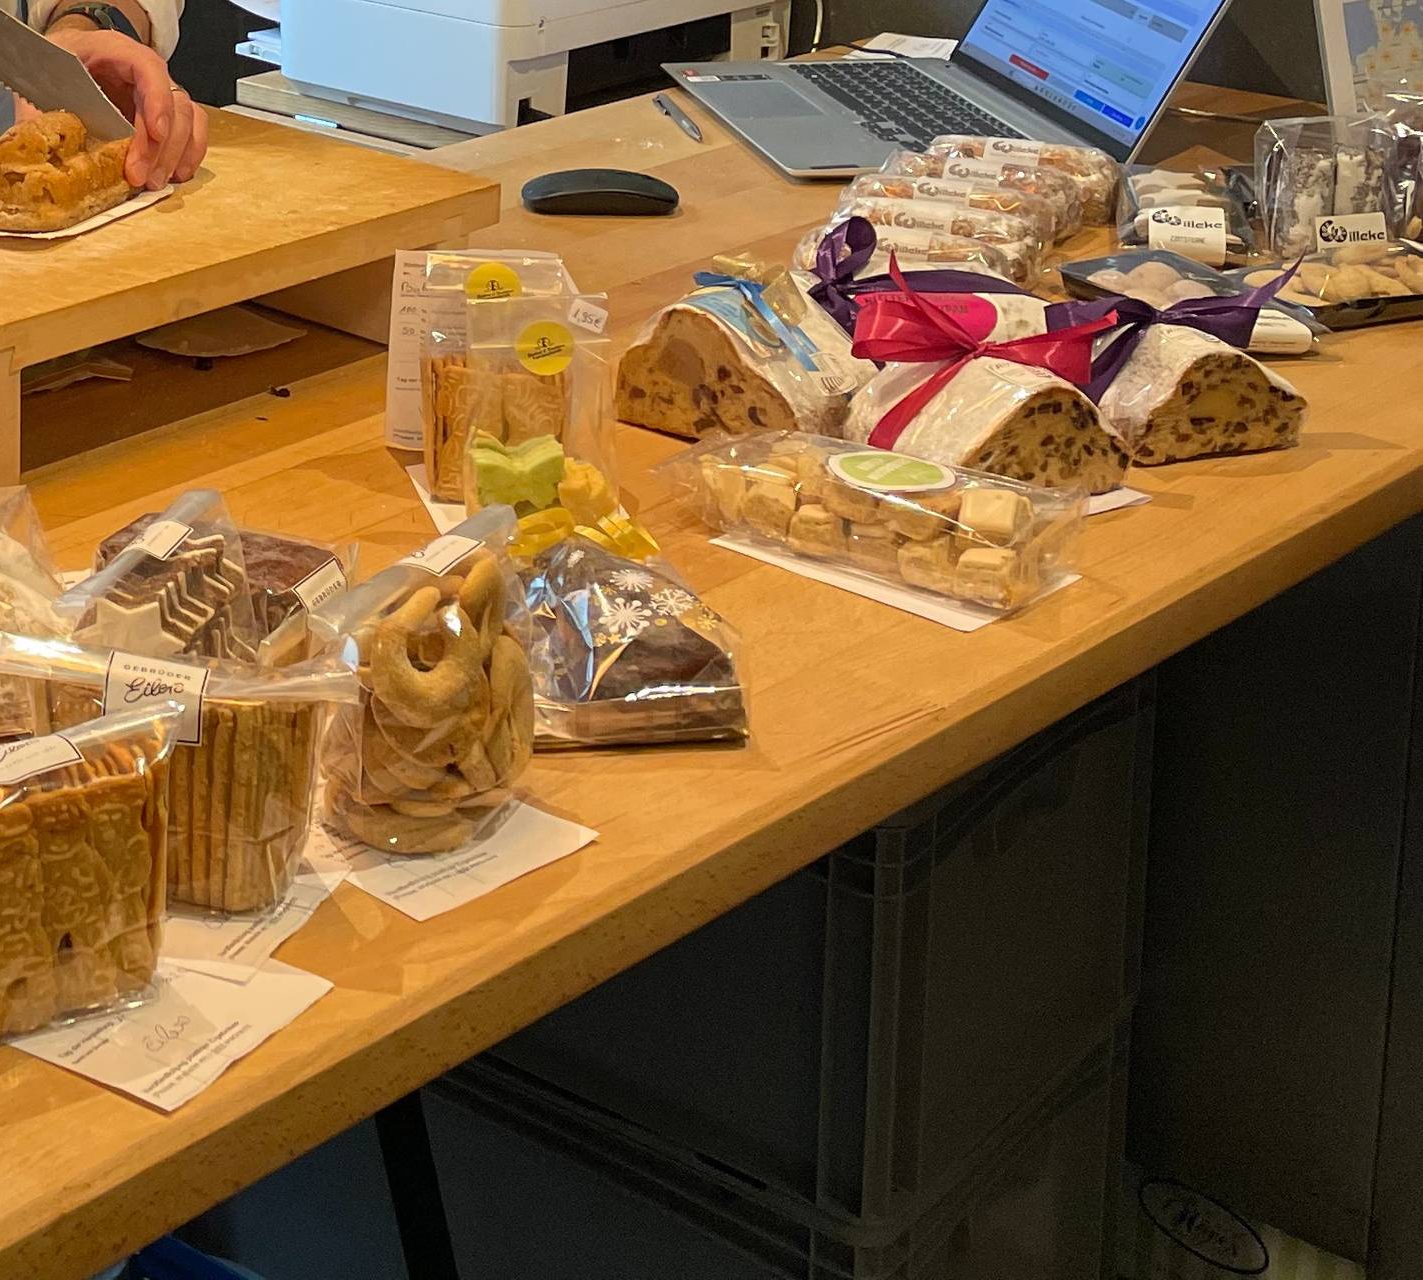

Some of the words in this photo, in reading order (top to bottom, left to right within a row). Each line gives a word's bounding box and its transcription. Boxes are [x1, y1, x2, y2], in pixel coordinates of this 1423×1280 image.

[1152, 208, 1223, 229] Willeke
[1319, 219, 1386, 243] Willeke
[123, 664, 192, 681] GEBRÜDER
